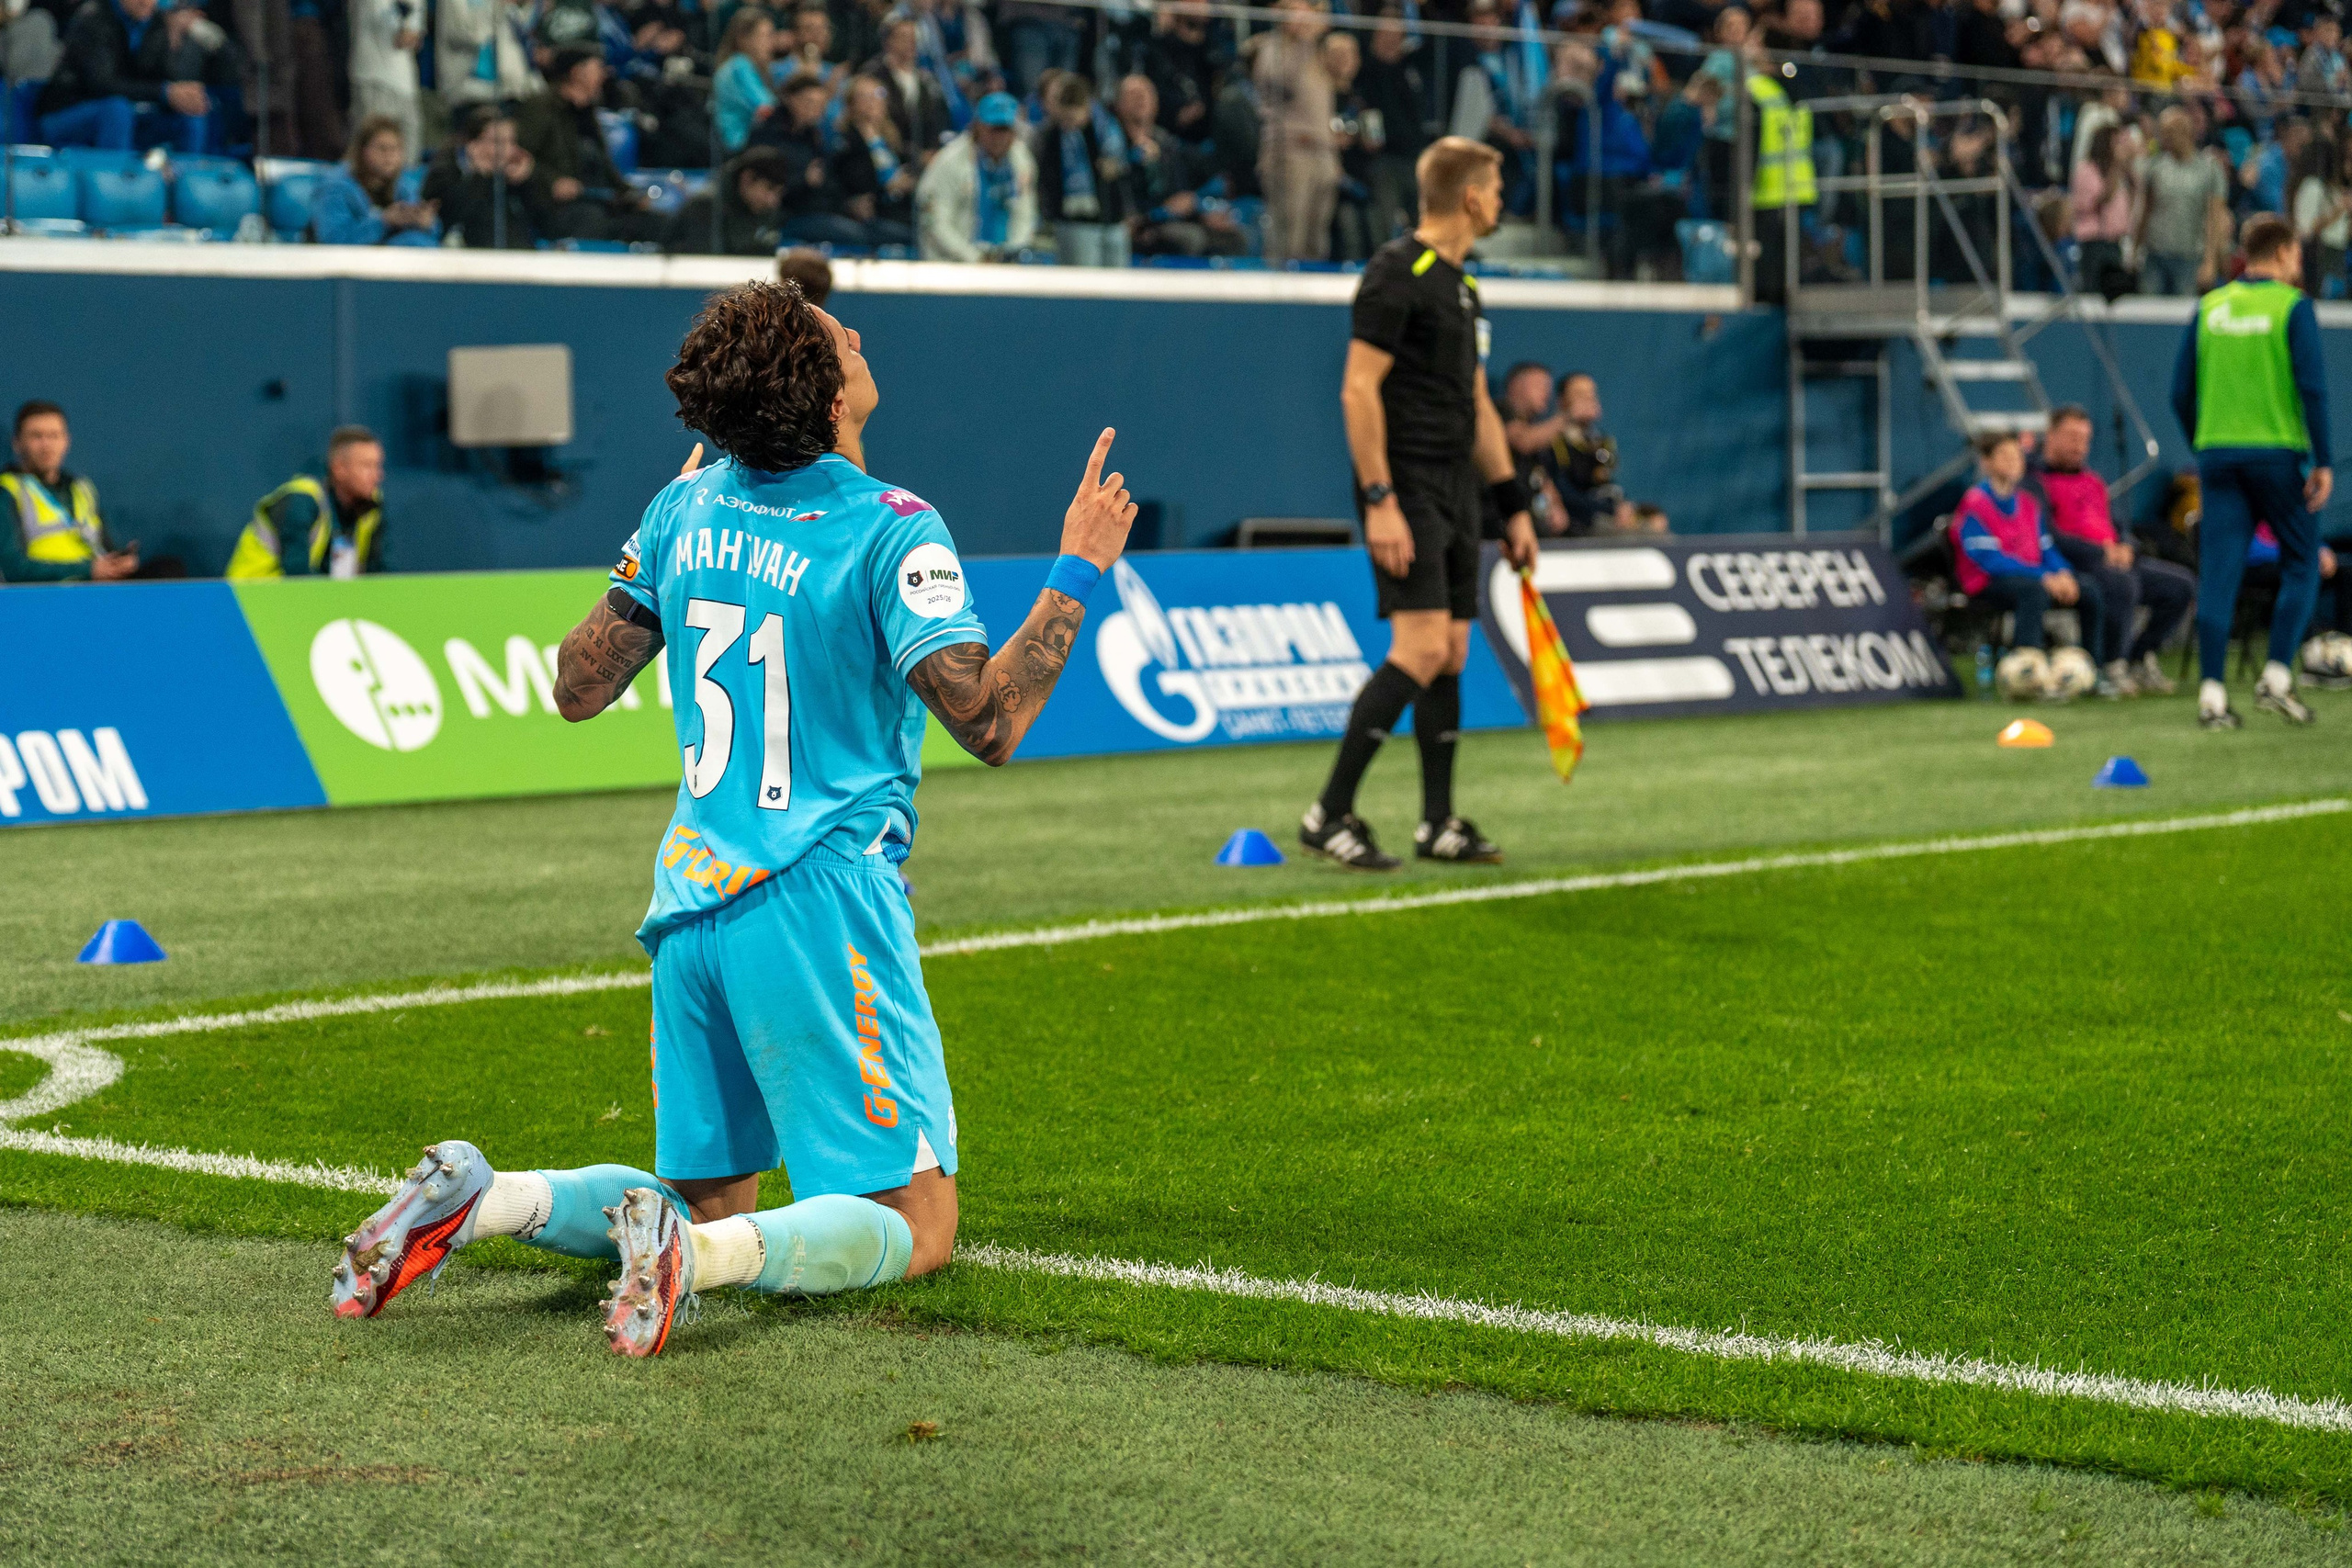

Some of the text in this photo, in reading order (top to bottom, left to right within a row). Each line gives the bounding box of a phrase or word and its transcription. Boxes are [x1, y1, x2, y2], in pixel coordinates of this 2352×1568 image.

[927, 594, 952, 604] 2025/26
[929, 569, 959, 582] МИР
[1687, 549, 1886, 613] СЕВЕРЕН
[1723, 630, 1947, 696] ТЕЛЕКОМ
[684, 597, 794, 812] 31
